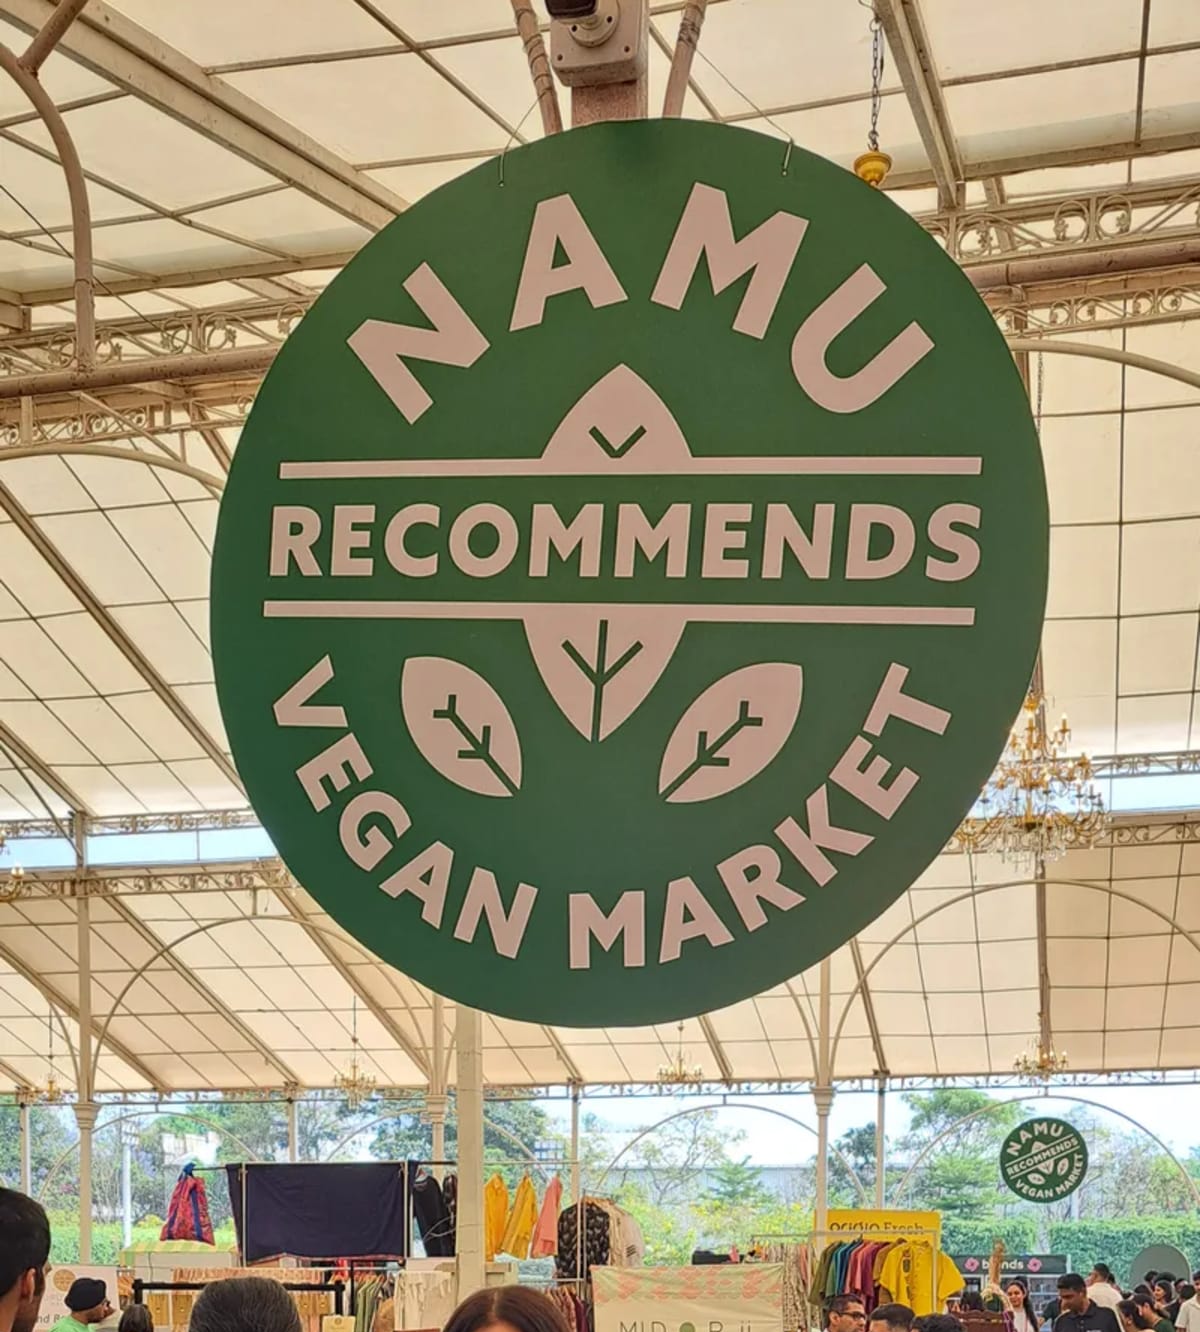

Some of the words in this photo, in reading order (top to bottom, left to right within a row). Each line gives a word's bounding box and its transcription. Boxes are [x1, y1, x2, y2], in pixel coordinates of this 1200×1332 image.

[346, 181, 935, 424] NAMU
[268, 502, 983, 582] RECOMMENDS
[272, 654, 539, 959] VEGAN
[568, 661, 956, 969] MARKET
[1006, 1121, 1064, 1156] NAMU
[1006, 1137, 1079, 1175] RECOMMENDS
[1015, 1178, 1054, 1198] VEGAN
[1055, 1152, 1084, 1195] MARKET
[982, 1259, 1024, 1270] bnds
